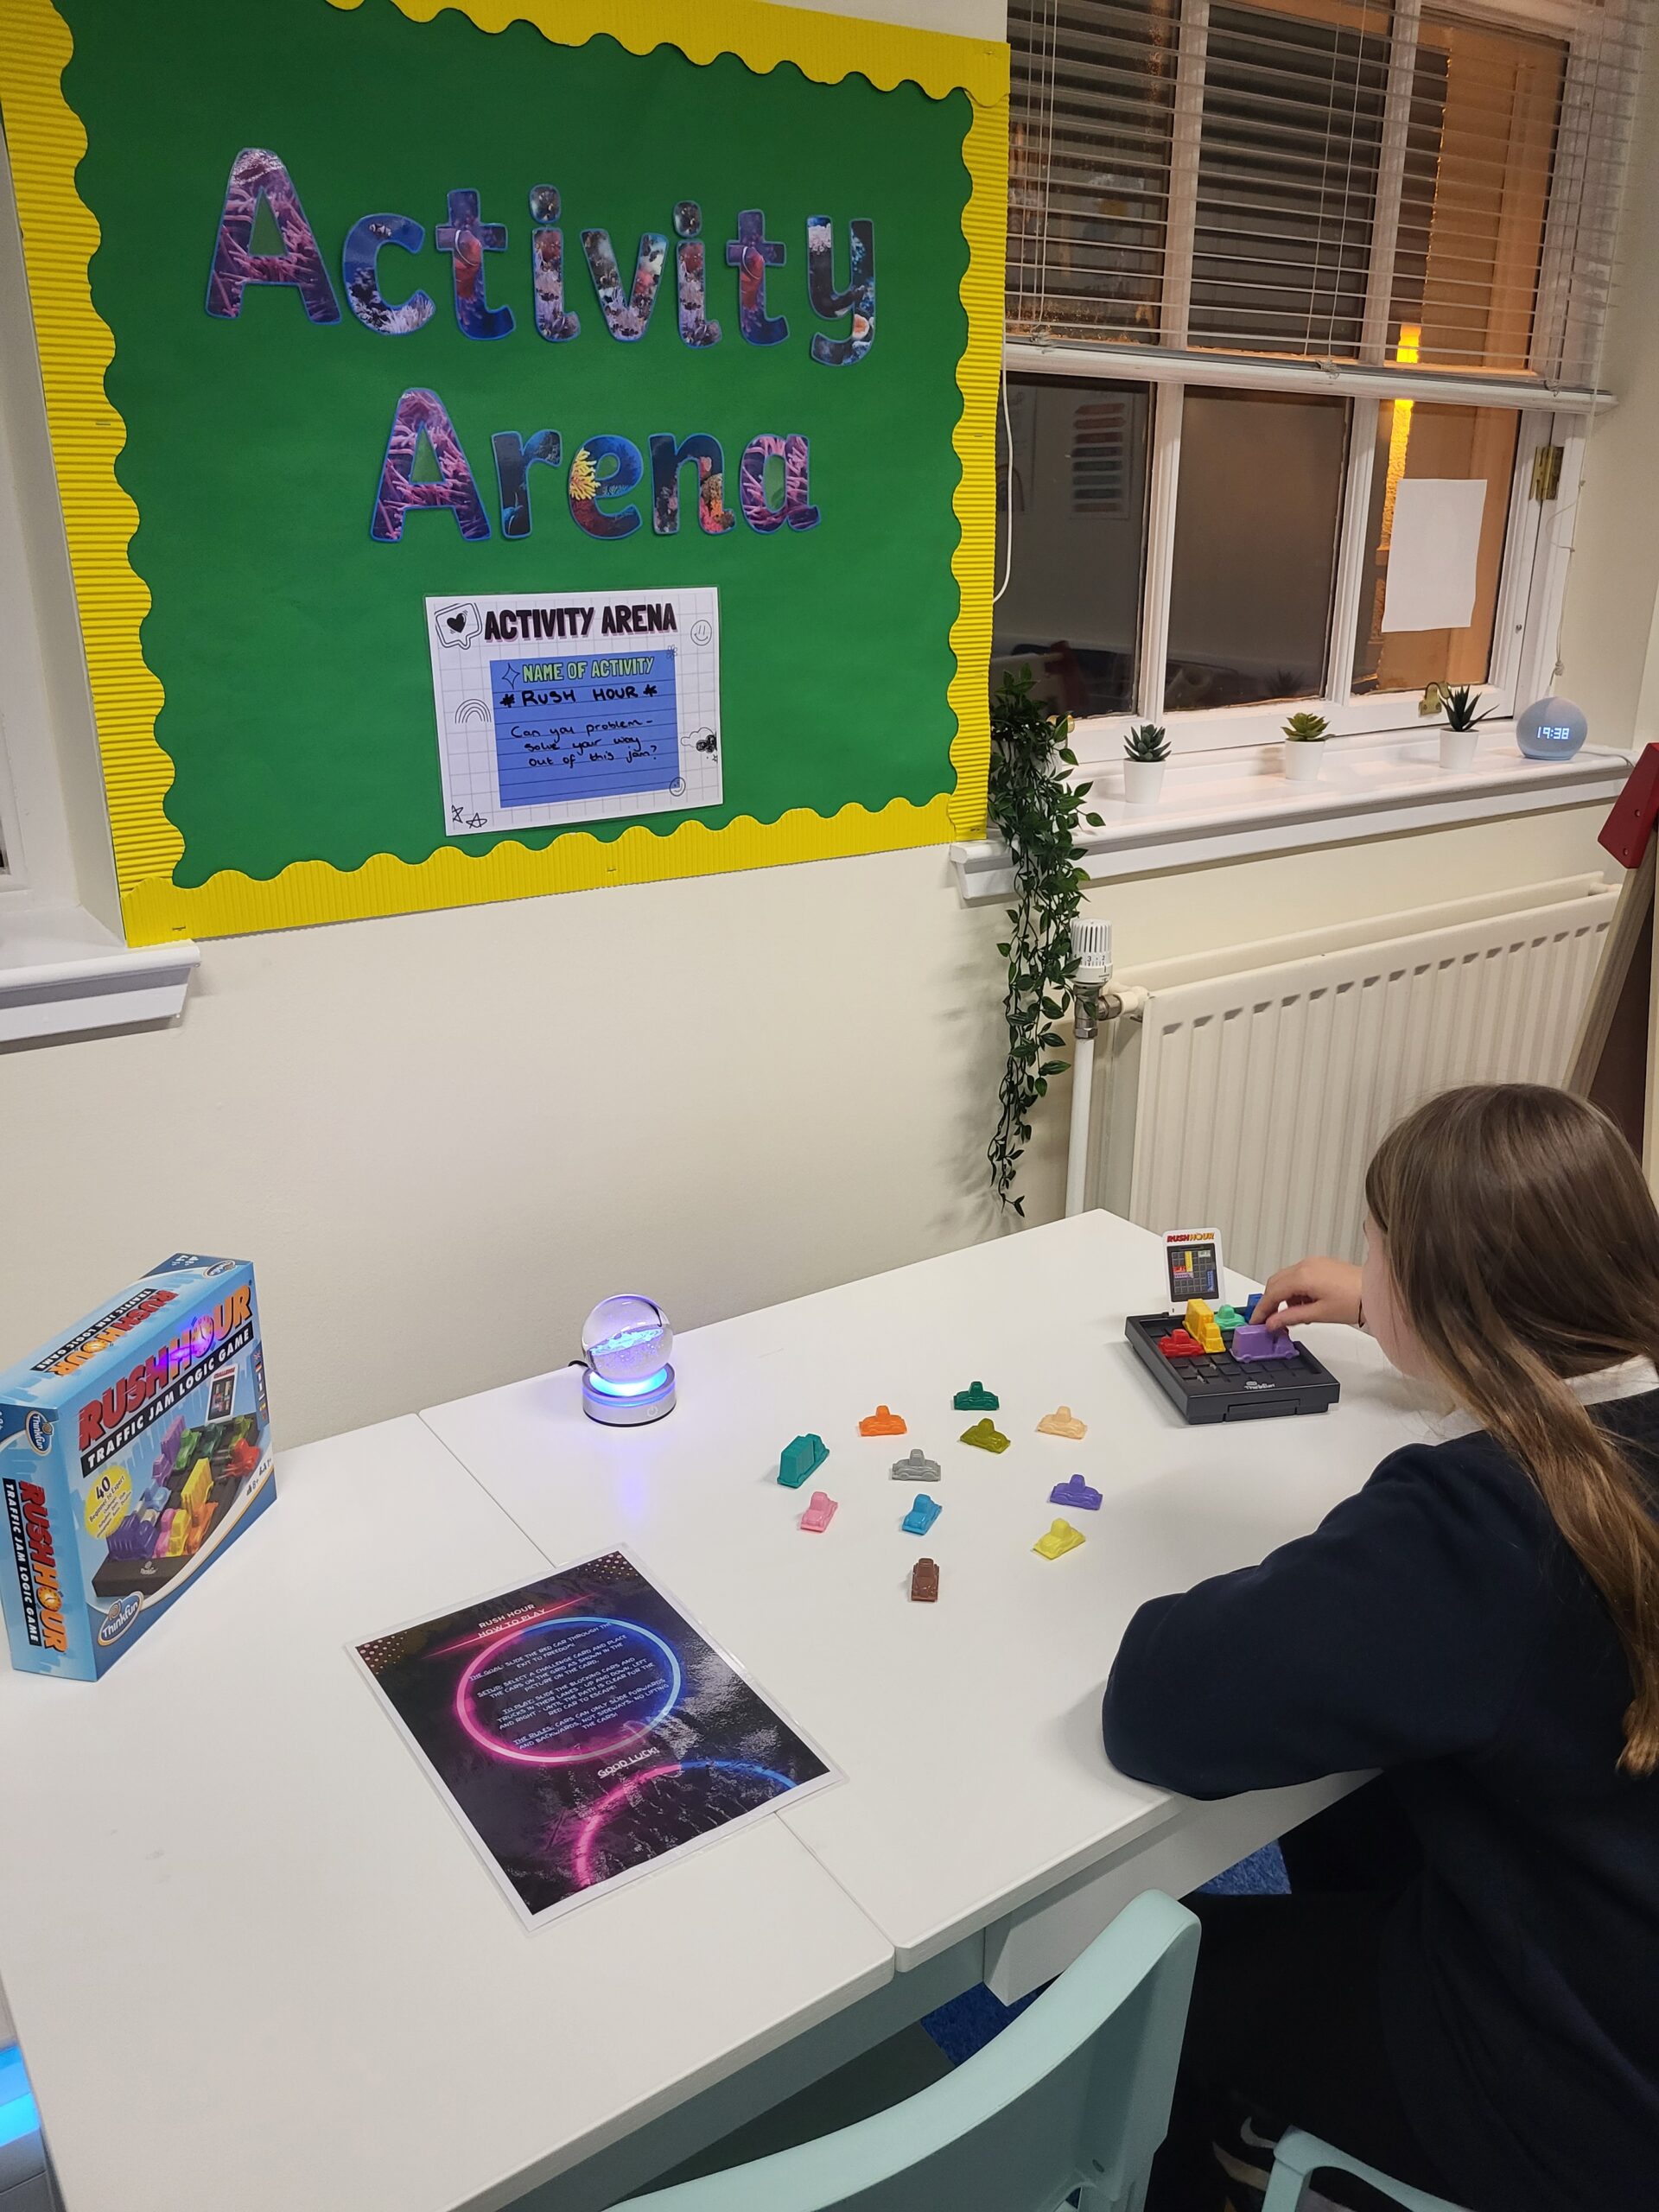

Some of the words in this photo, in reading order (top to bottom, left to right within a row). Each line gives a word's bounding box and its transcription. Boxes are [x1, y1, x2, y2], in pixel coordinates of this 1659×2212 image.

[205, 147, 875, 366] Activity
[370, 387, 820, 542] Arena
[484, 606, 594, 640] ACTIVITY
[601, 603, 677, 634] ARENA
[523, 664, 563, 683] NAME
[567, 661, 588, 680] OF
[591, 658, 654, 677] ACTIVITY
[522, 690, 575, 706] RUSH
[593, 685, 639, 701] HOUR
[512, 726, 541, 738] Can
[550, 726, 575, 743] you
[572, 738, 601, 755] your
[613, 736, 641, 752] way
[1537, 726, 1569, 740] 19:38
[563, 753, 575, 769] of
[589, 750, 614, 760] this
[626, 745, 657, 764] jam?
[1166, 1234, 1189, 1243] RUSH
[1189, 1232, 1215, 1241] HOUR
[112, 1289, 179, 1332] RUSH
[119, 1291, 151, 1313] TRAFFIC
[95, 1314, 116, 1327] JAM
[45, 1327, 125, 1376] HOUR
[67, 1327, 97, 1348] LOGIC
[39, 1350, 66, 1370] GAME
[79, 1346, 169, 1452] RUSH
[169, 1285, 252, 1380] HOUR
[87, 1418, 144, 1471] TRAFFIC
[149, 1392, 175, 1422] JAM
[180, 1360, 215, 1395] LOGIC
[218, 1327, 251, 1363] GAME
[96, 1476, 111, 1500] 40
[5, 1484, 21, 1533] TRAFFIC
[19, 1480, 56, 1567] RUSH
[14, 1536, 26, 1561] JAM
[19, 1567, 31, 1604] LOGIC
[33, 1562, 68, 1652] HOUR
[478, 1624, 505, 1638] HOW
[505, 1619, 518, 1628] TO
[520, 1609, 545, 1623] PLAY
[479, 1614, 505, 1628] RUSH
[506, 1604, 536, 1618] HOUR
[24, 1607, 38, 1642] GAME
[470, 1673, 482, 1681] THE
[505, 1656, 524, 1667] SLIDE
[524, 1650, 537, 1659] THE
[538, 1645, 553, 1654] RED
[553, 1639, 567, 1649] CAR
[567, 1627, 600, 1642] THROUGH
[503, 1675, 527, 1687] SELECT
[536, 1657, 572, 1674] CHALLENGE
[572, 1649, 591, 1659] CARD
[607, 1635, 627, 1645] PLACE
[505, 1683, 524, 1693] CARS
[550, 1665, 567, 1675] GRID
[577, 1651, 602, 1663] SHOWN
[610, 1642, 624, 1650] THE
[517, 1659, 531, 1669] EXIT
[497, 1709, 526, 1723] TRUCKS
[535, 1697, 556, 1707] THEIR
[556, 1687, 579, 1699] LANES
[596, 1675, 610, 1683] AND
[632, 1657, 648, 1668] LEFT
[524, 1676, 553, 1692] PICTURE
[536, 1690, 555, 1700] SLIDE
[569, 1671, 601, 1687] BLOCKING
[601, 1663, 620, 1674] CARS
[621, 1657, 636, 1666] AND
[499, 1720, 515, 1730] AND
[515, 1711, 536, 1723] RIGHT
[543, 1700, 563, 1711] UNTIL
[563, 1694, 577, 1702] THE
[577, 1686, 596, 1697] PATH
[605, 1673, 627, 1685] CLEAR
[627, 1668, 641, 1676] FOR
[641, 1662, 655, 1670] THE
[513, 1736, 529, 1746] THE
[555, 1716, 575, 1727] CARS
[575, 1710, 589, 1719] CAN
[590, 1702, 608, 1713] ONLY
[608, 1694, 628, 1704] SLIDE
[628, 1678, 666, 1696] FORWARDS
[548, 1707, 563, 1716] RED
[563, 1700, 578, 1710] CAR
[518, 1740, 534, 1750] AND
[581, 1714, 596, 1723] NOT
[645, 1683, 670, 1697] LIFTING
[581, 1721, 596, 1730] THE
[598, 1759, 627, 1778] GOOD
[628, 1747, 660, 1763] LUCK!
